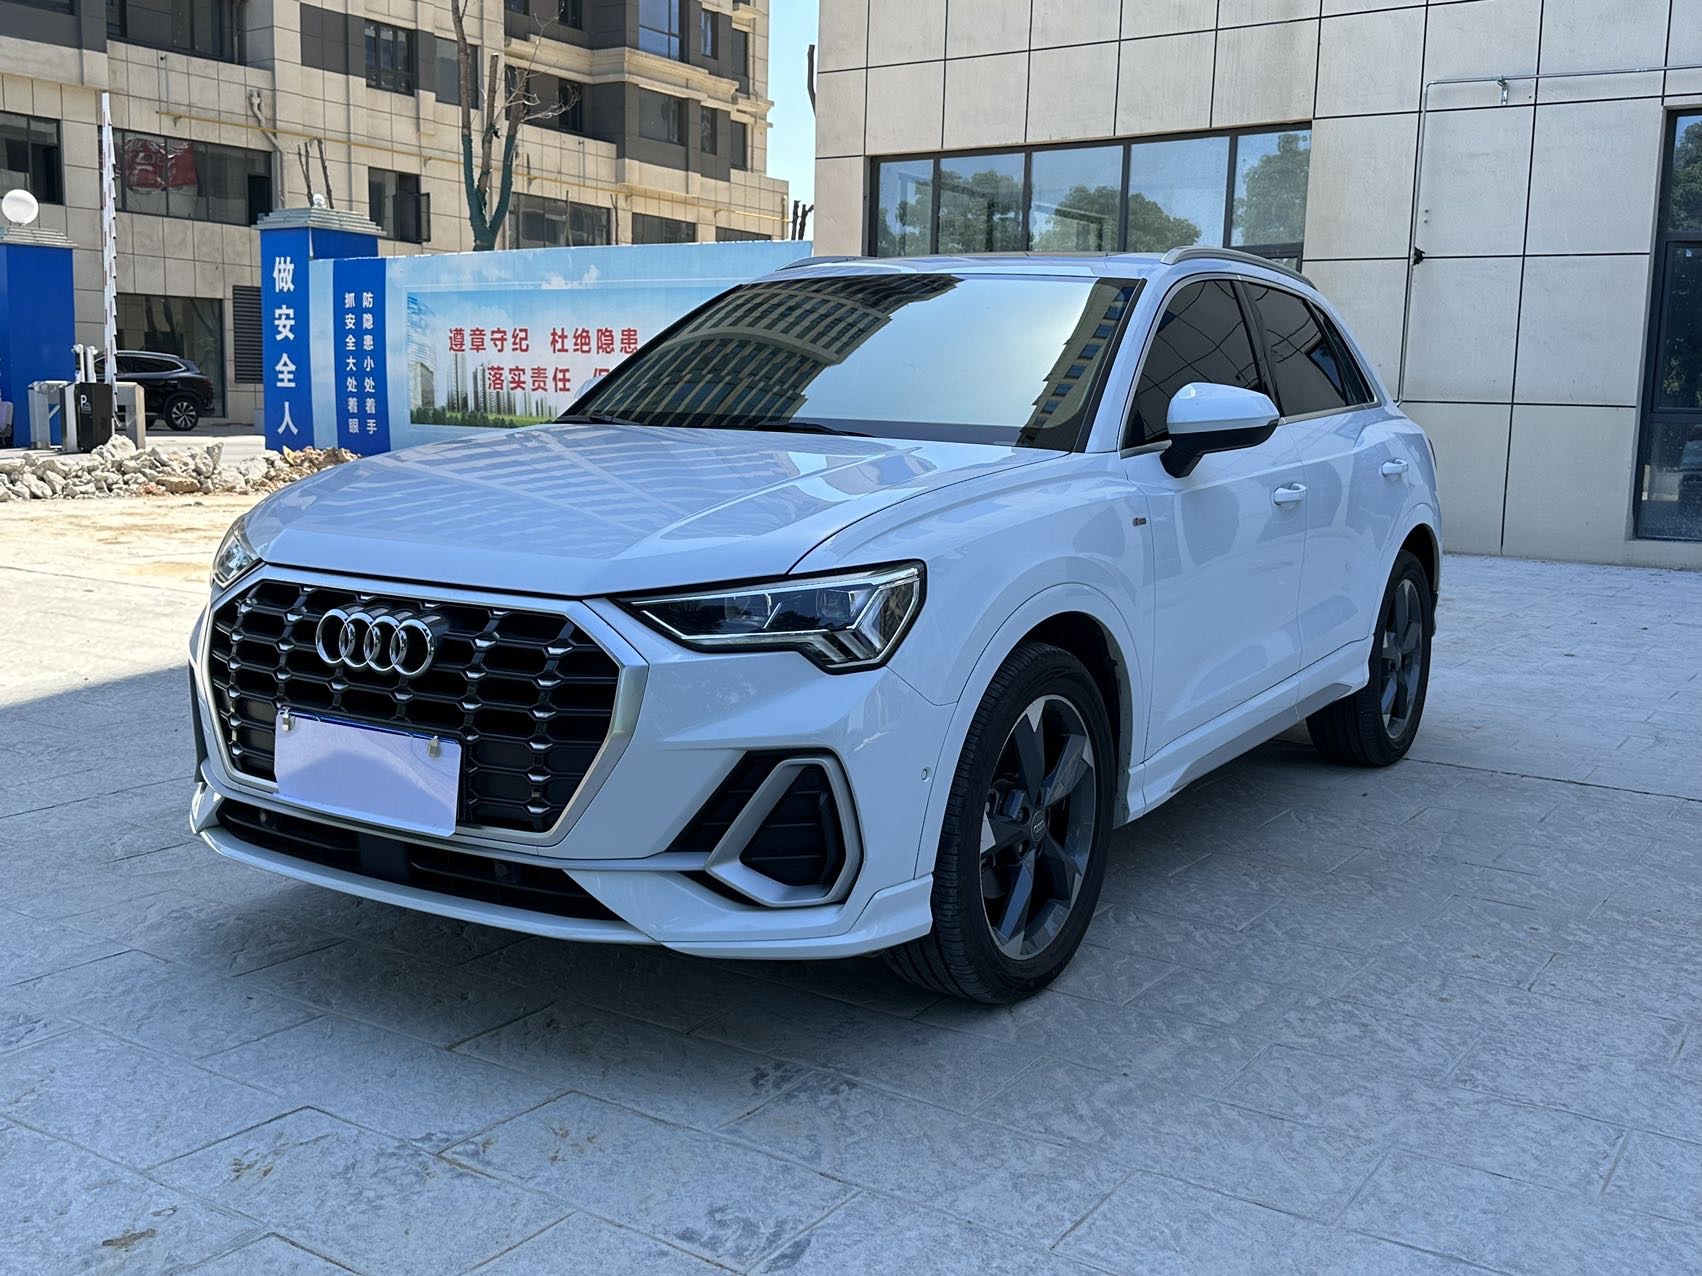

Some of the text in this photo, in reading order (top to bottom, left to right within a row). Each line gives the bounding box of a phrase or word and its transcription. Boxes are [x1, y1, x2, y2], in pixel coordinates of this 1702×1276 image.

[273, 256, 298, 435] 做安全人
[344, 292, 359, 434] 抓安全大处着眼
[362, 291, 377, 435] 防隐患小处着手
[449, 327, 639, 354] 遵章守纪 杜绝隐患
[487, 366, 571, 393] 落实责任
